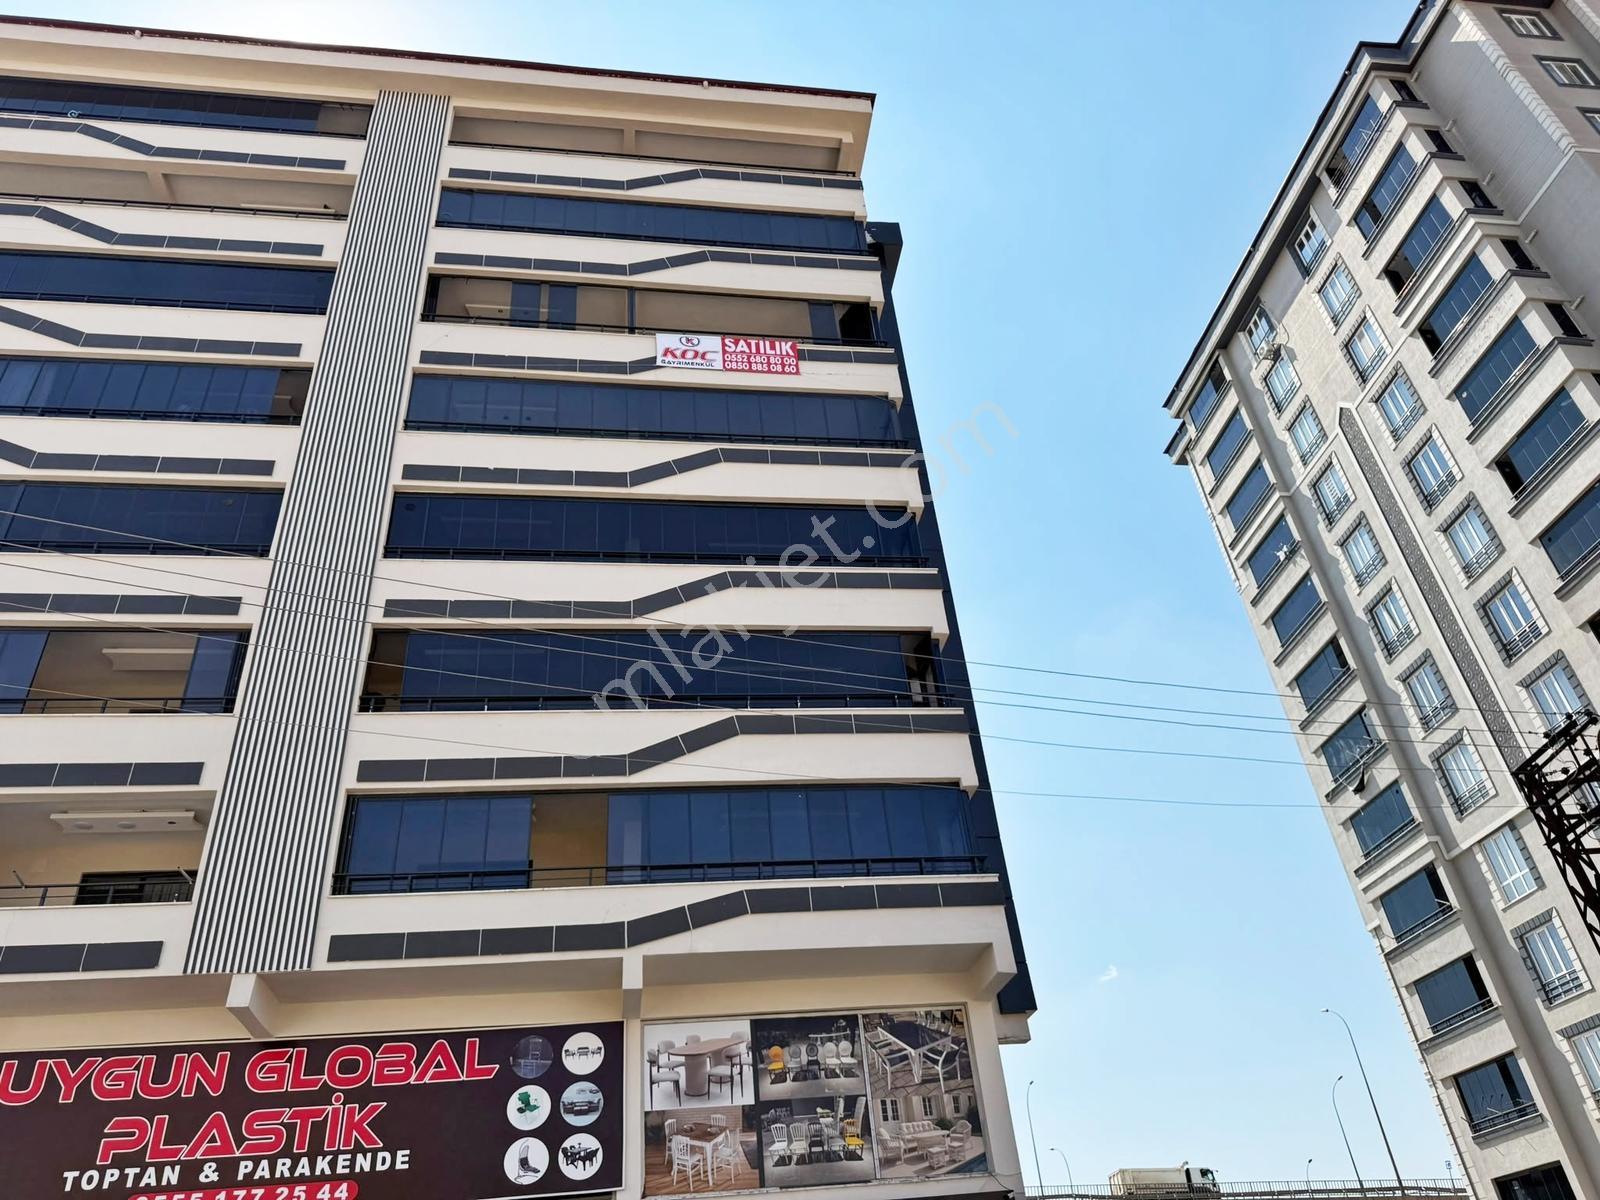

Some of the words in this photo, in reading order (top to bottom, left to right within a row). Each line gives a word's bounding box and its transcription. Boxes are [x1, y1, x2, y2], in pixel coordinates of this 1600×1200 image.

[724, 353, 748, 362] 0552
[769, 356, 782, 364] 80
[783, 357, 796, 365] 00
[724, 361, 749, 370] 0850
[770, 364, 782, 372] 08
[784, 365, 796, 373] 60
[0, 1052, 231, 1106] UYGUN
[244, 1039, 500, 1096] GLOBAL
[97, 1092, 386, 1164] PLASTİK
[62, 1165, 181, 1192] TOPTAN
[199, 1162, 219, 1183] &
[237, 1150, 411, 1181] PARAKENDE
[317, 1183, 348, 1200] 44
